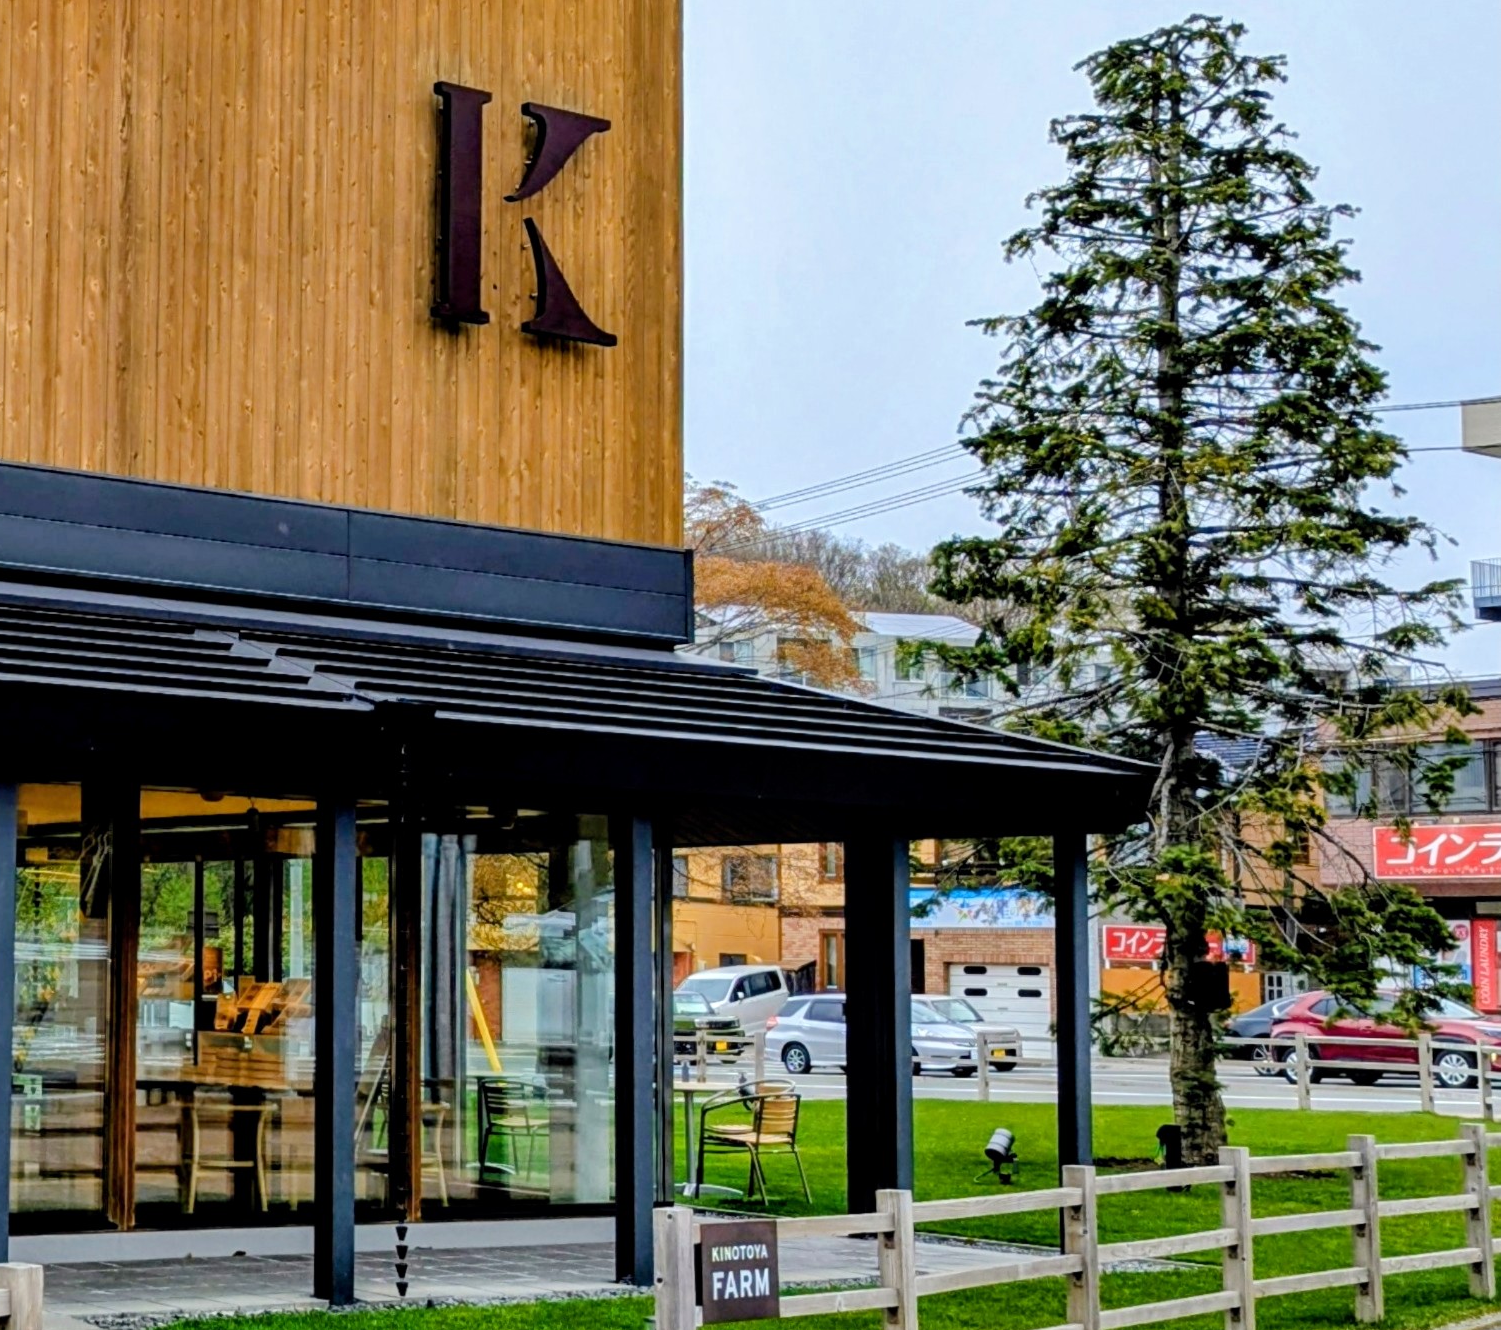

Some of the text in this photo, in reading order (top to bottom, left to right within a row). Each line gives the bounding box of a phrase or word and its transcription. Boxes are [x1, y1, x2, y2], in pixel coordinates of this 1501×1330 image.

[431, 81, 617, 347] K
[1479, 926, 1491, 1004] COIN LAUNDRY
[711, 1244, 768, 1262] KINOTOYA
[712, 1268, 770, 1301] FARM
